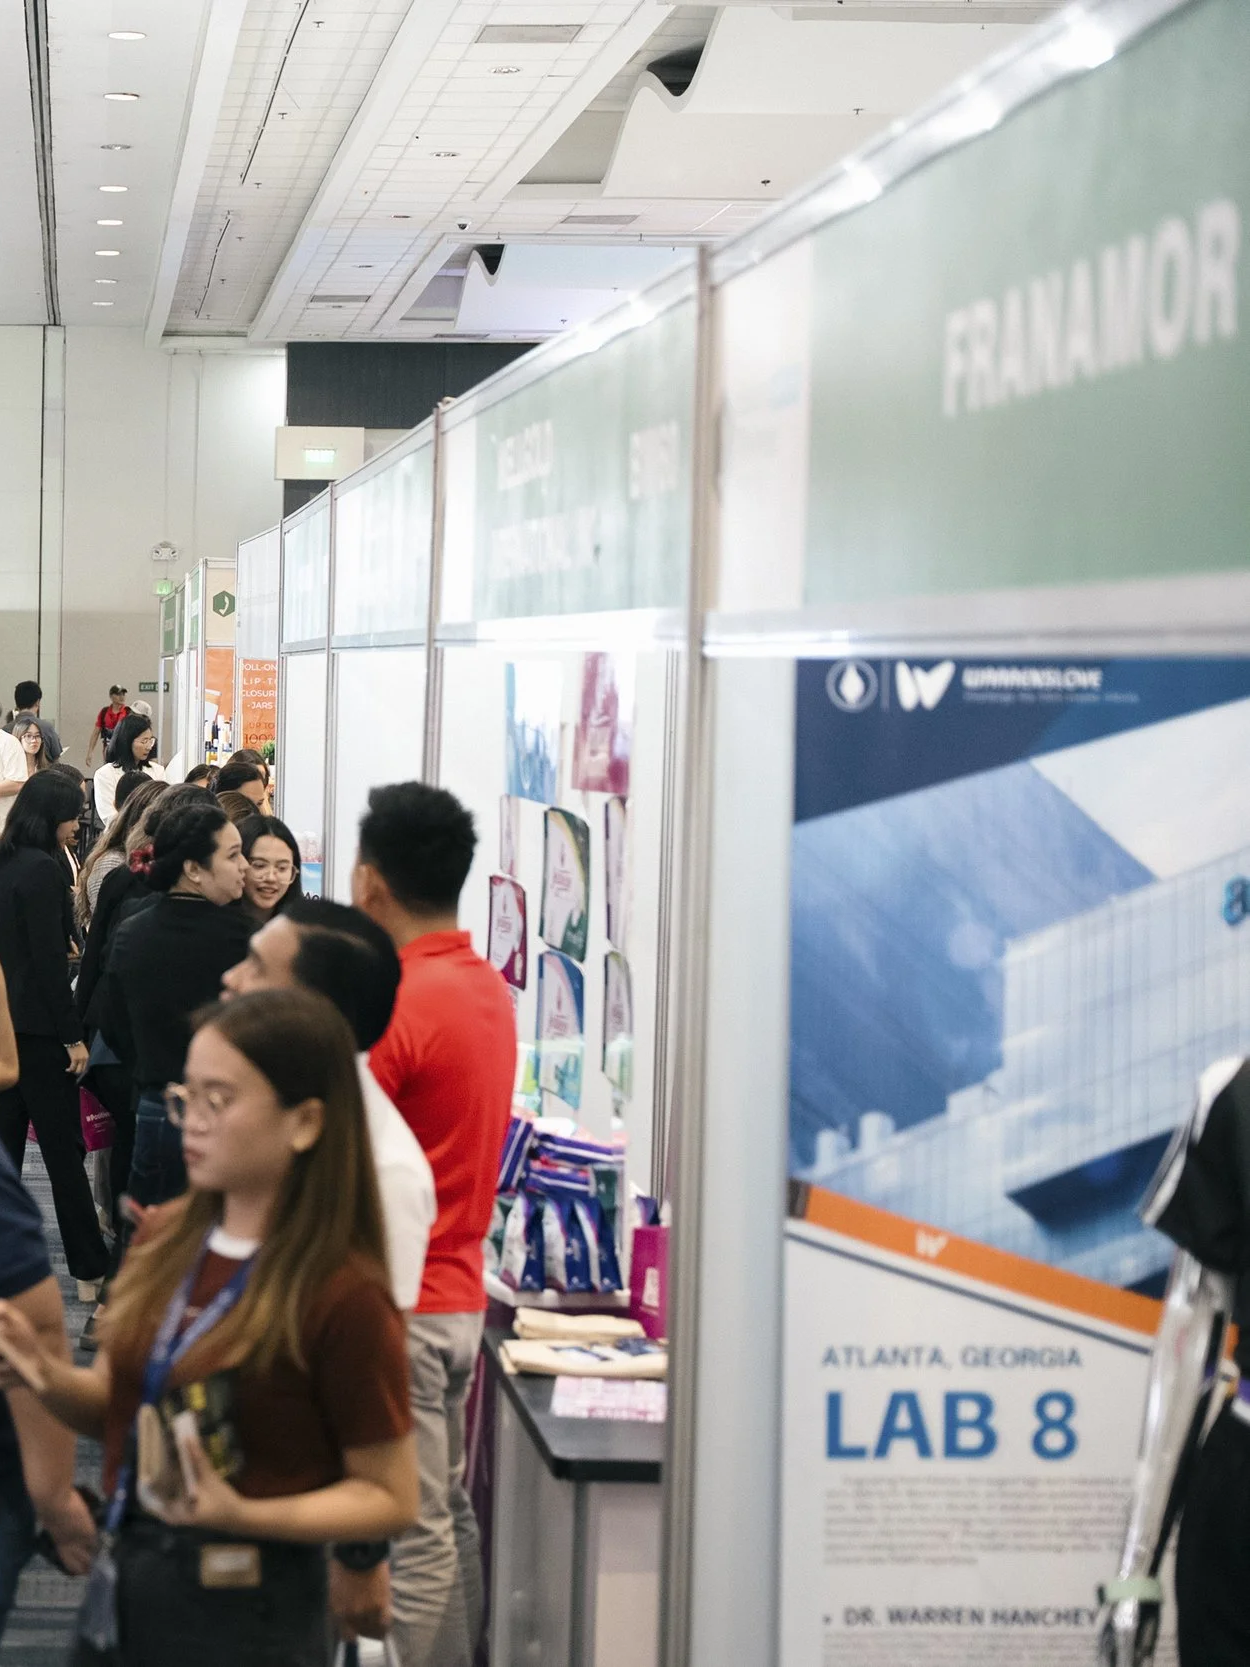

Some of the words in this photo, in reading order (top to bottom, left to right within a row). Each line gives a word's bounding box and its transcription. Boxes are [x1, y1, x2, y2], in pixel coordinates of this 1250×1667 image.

[943, 197, 1241, 419] FRANAMOR
[821, 1346, 953, 1370] ATLANTA,
[959, 1346, 1084, 1369] GEORGIA
[825, 1390, 998, 1459] LAB
[1031, 1390, 1079, 1460] 8
[844, 1606, 881, 1626] DR.
[887, 1607, 986, 1626] WARREN
[990, 1607, 1099, 1627] HANCHEY
